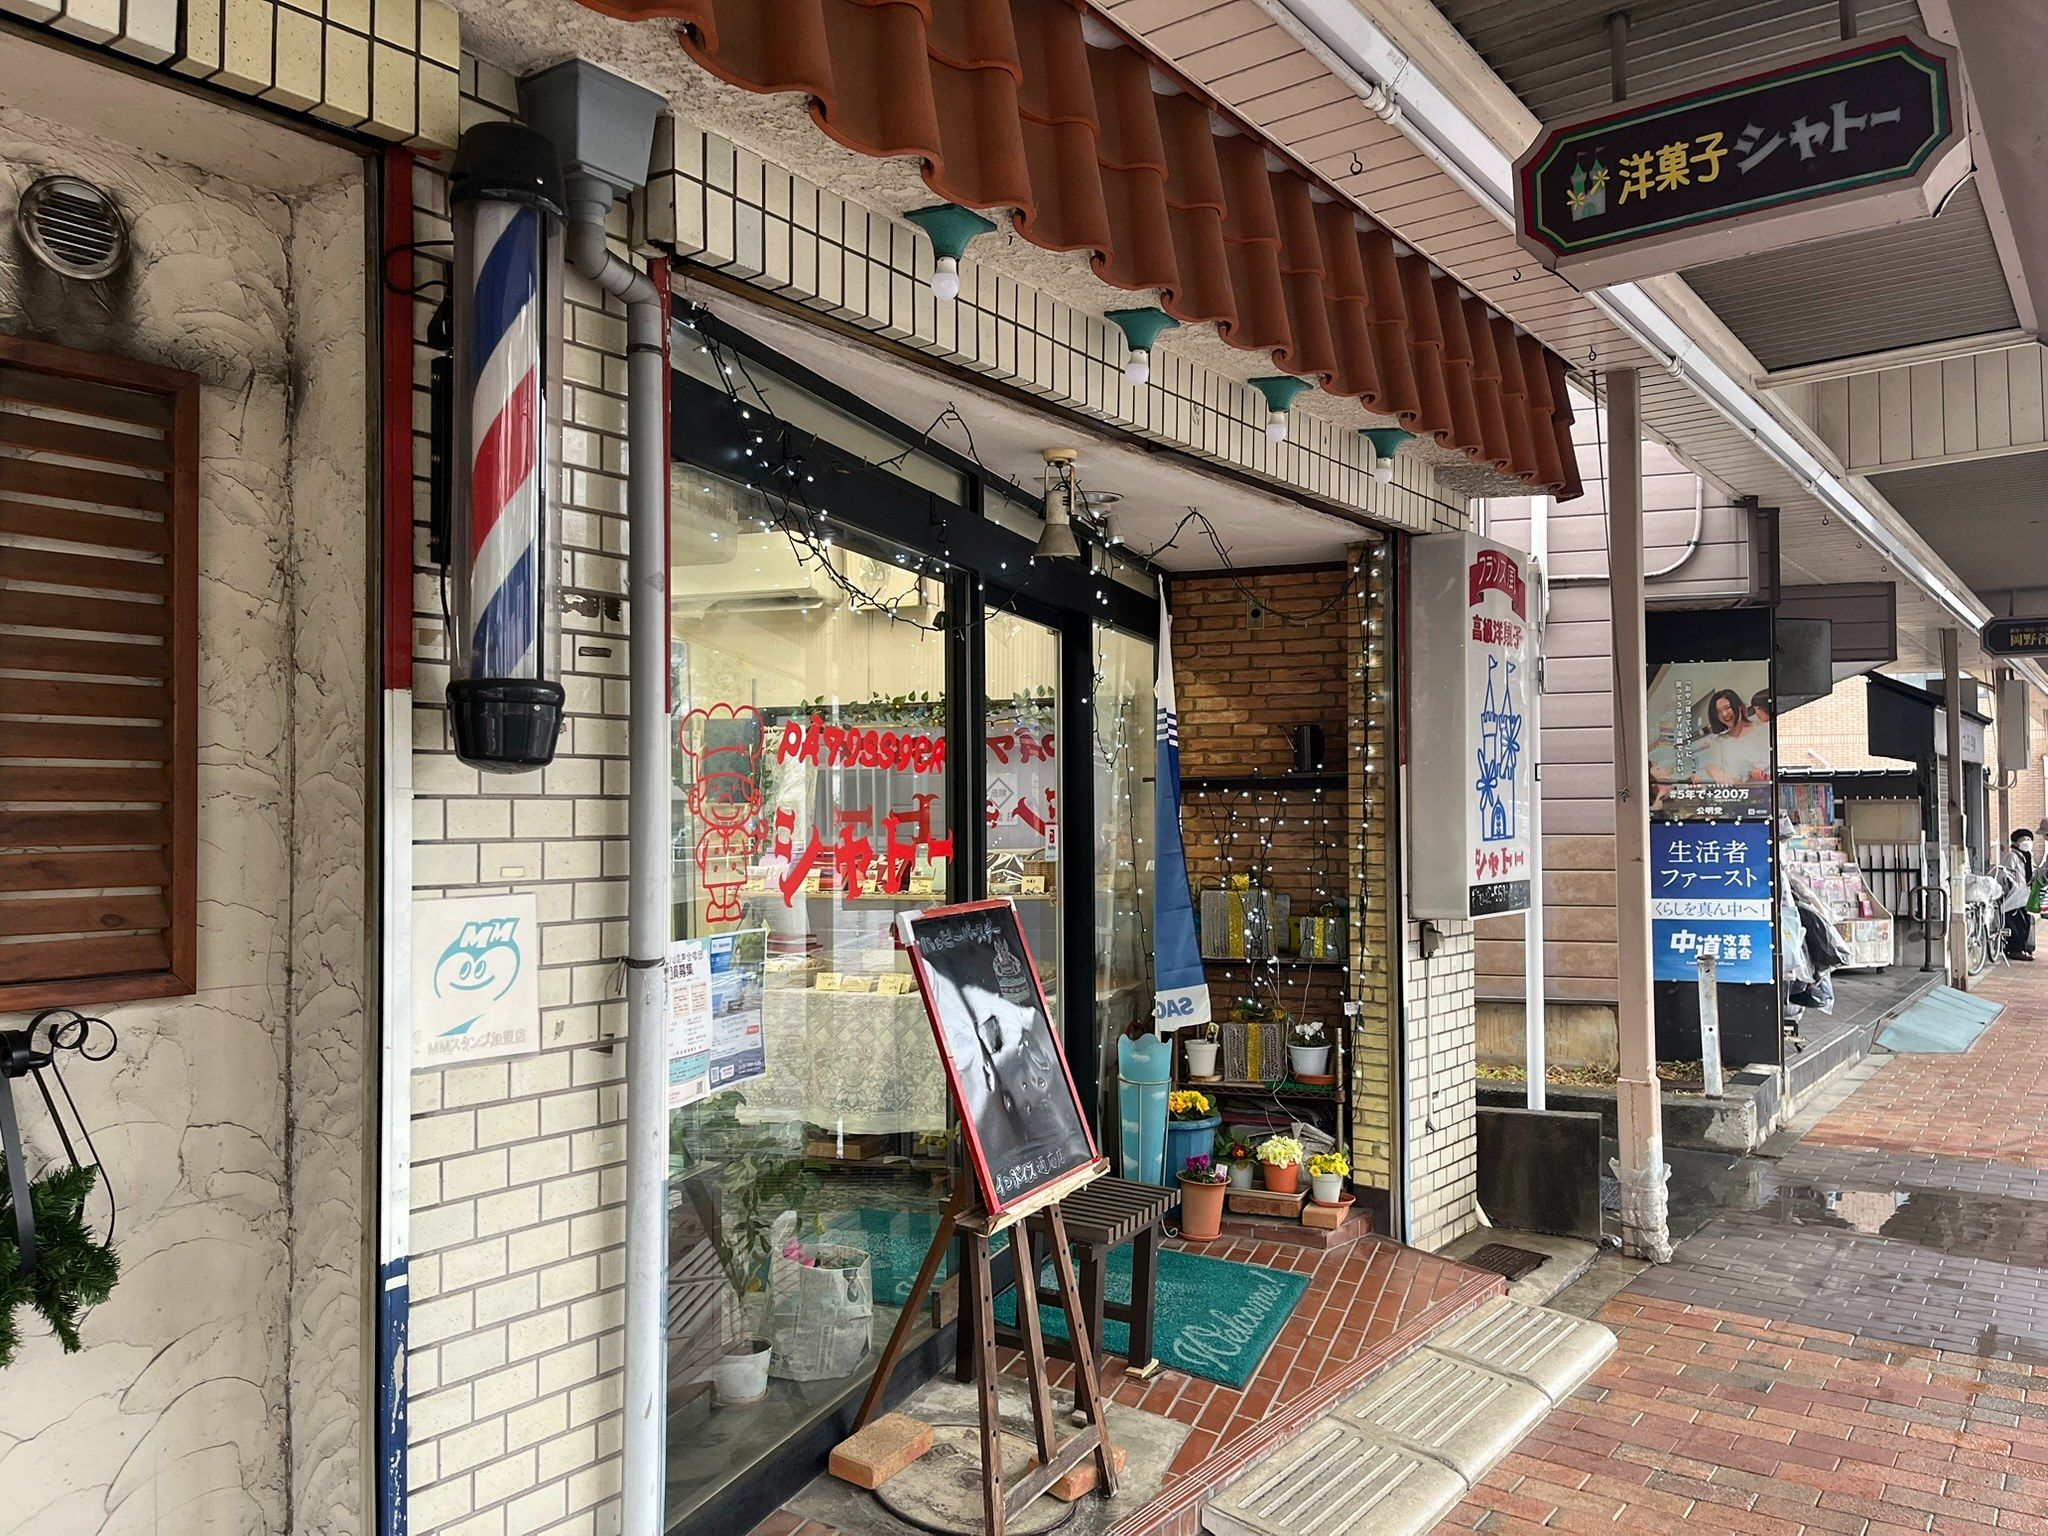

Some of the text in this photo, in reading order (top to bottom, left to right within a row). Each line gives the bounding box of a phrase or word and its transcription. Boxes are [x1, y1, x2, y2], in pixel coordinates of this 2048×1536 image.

[1618, 100, 1901, 205] 洋菓子 シャトー
[1472, 613, 1523, 650] 高級洋菓子
[1696, 806, 1724, 816] 公明党
[774, 806, 954, 909] シャトー
[1475, 846, 1524, 881] シャトー
[1668, 840, 1749, 864] 生活者
[1660, 867, 1758, 889] ファースト
[1670, 929, 1722, 960] 中道
[1723, 934, 1752, 947] 改革
[1723, 947, 1752, 960] 連合
